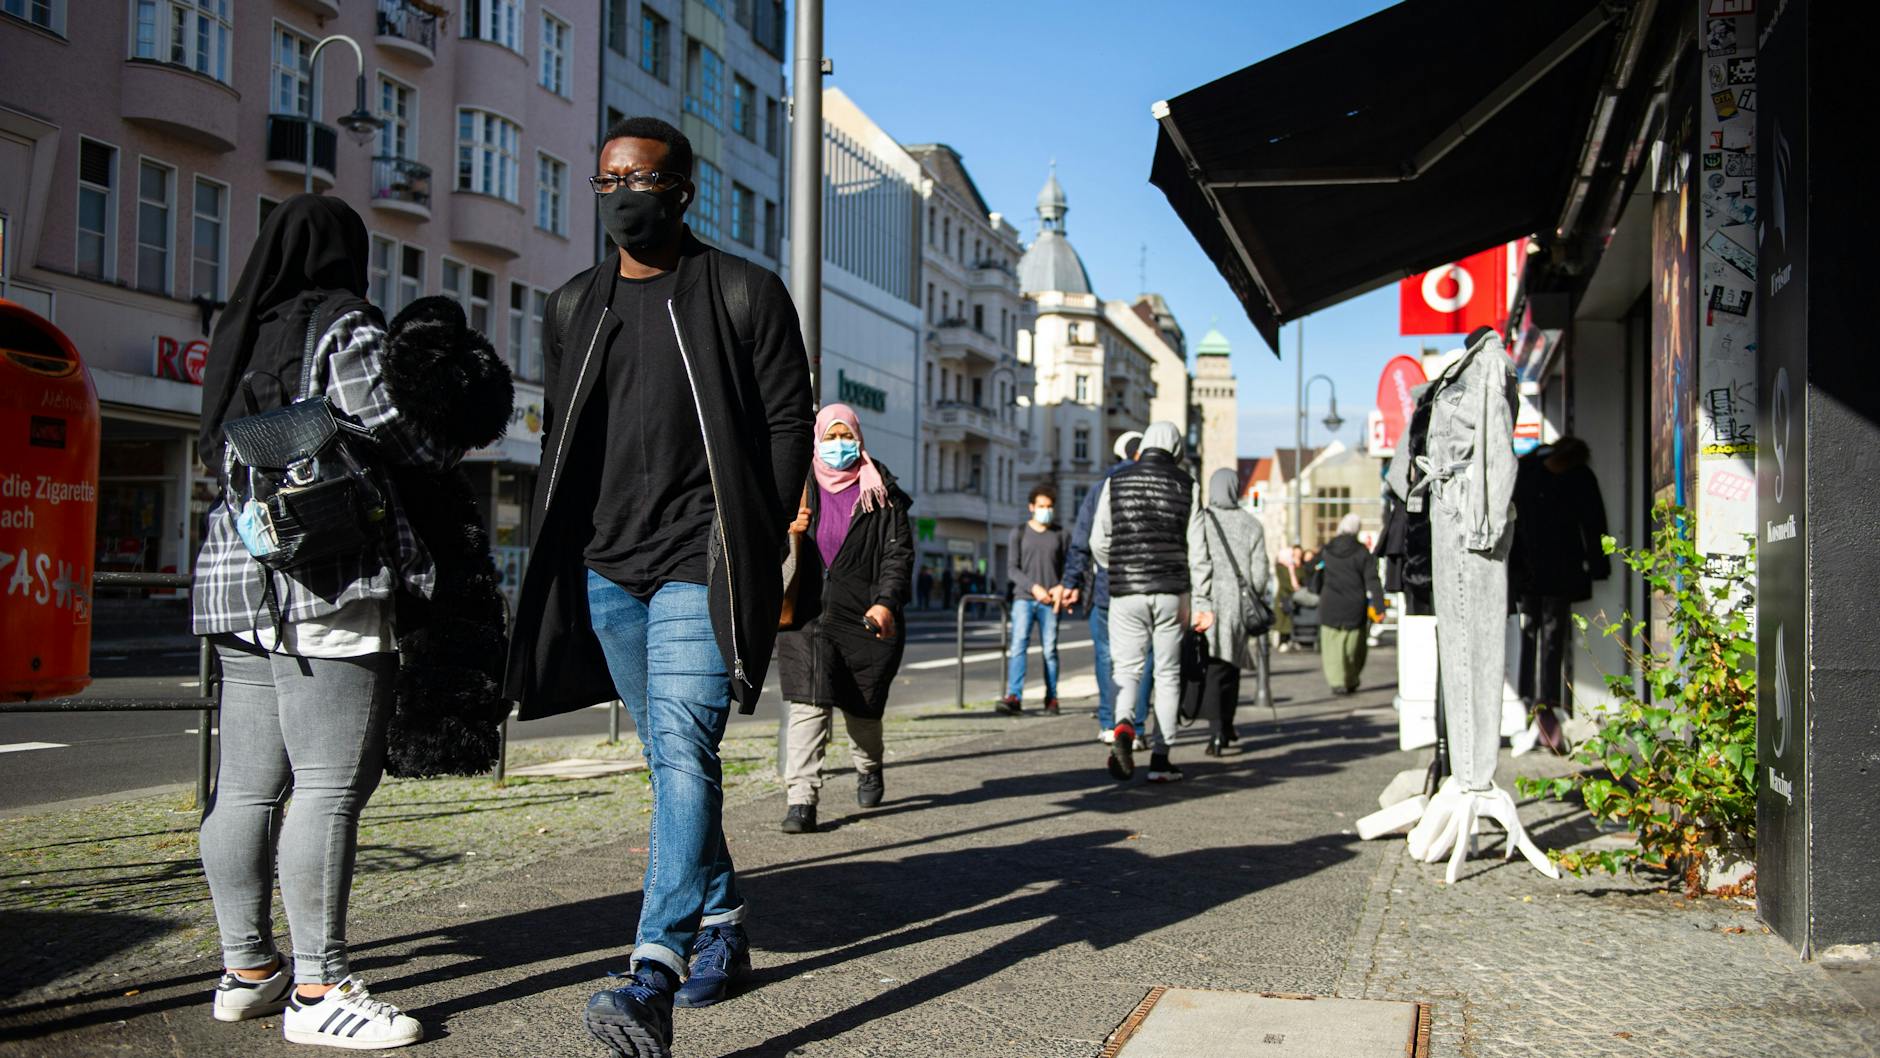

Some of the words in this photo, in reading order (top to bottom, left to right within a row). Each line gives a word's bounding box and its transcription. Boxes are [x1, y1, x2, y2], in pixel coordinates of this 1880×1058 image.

[2, 473, 31, 498] die
[35, 476, 95, 505] Zigarette
[1767, 514, 1797, 543] Kosmetik
